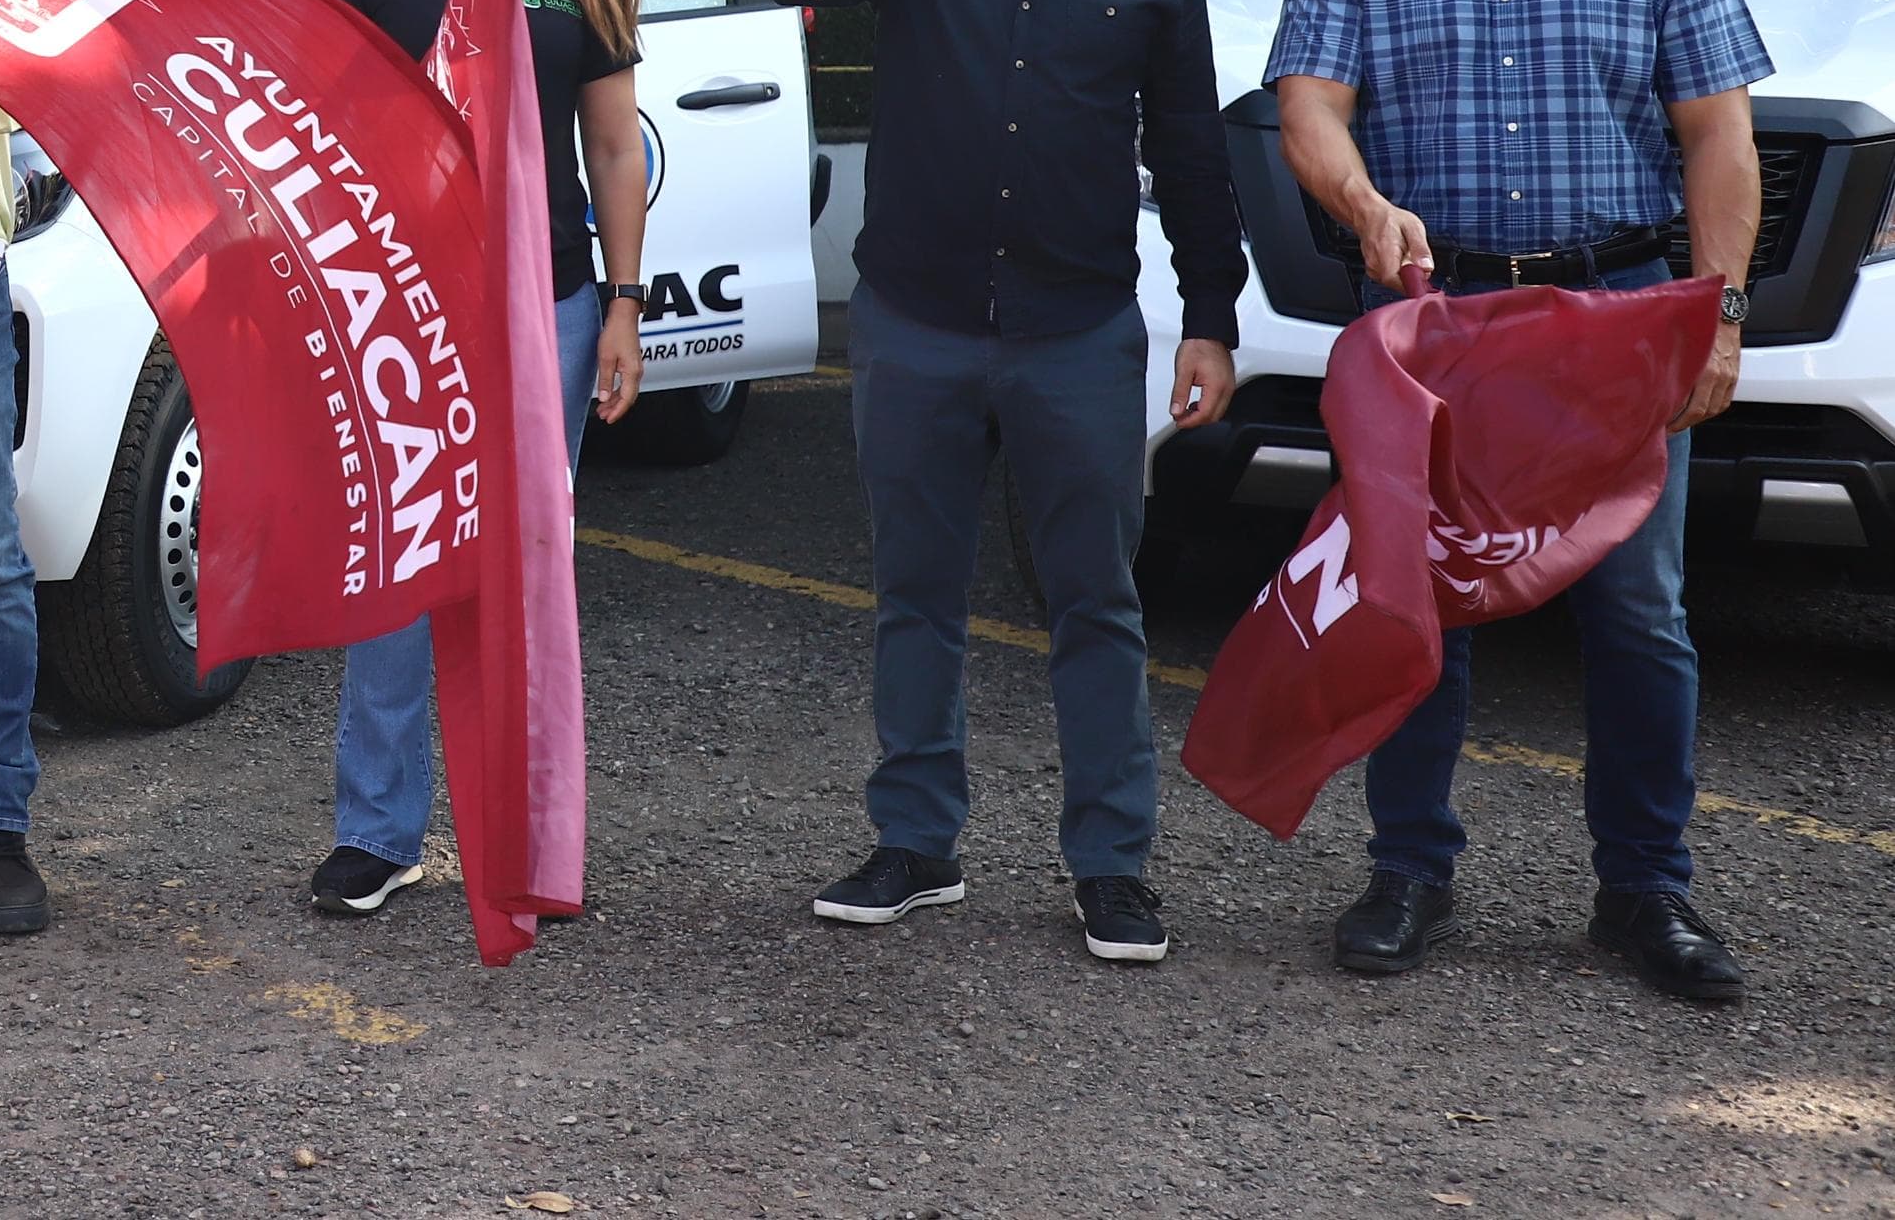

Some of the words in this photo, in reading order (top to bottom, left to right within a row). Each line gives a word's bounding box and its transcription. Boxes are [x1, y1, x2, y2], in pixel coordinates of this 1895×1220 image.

[132, 81, 259, 234] CAPITAL
[269, 251, 308, 309] DE
[304, 329, 367, 597] BIENESTAR
[195, 36, 476, 445] AYUNTAMIENTO
[452, 458, 480, 548] DE
[684, 333, 745, 356] TODOS
